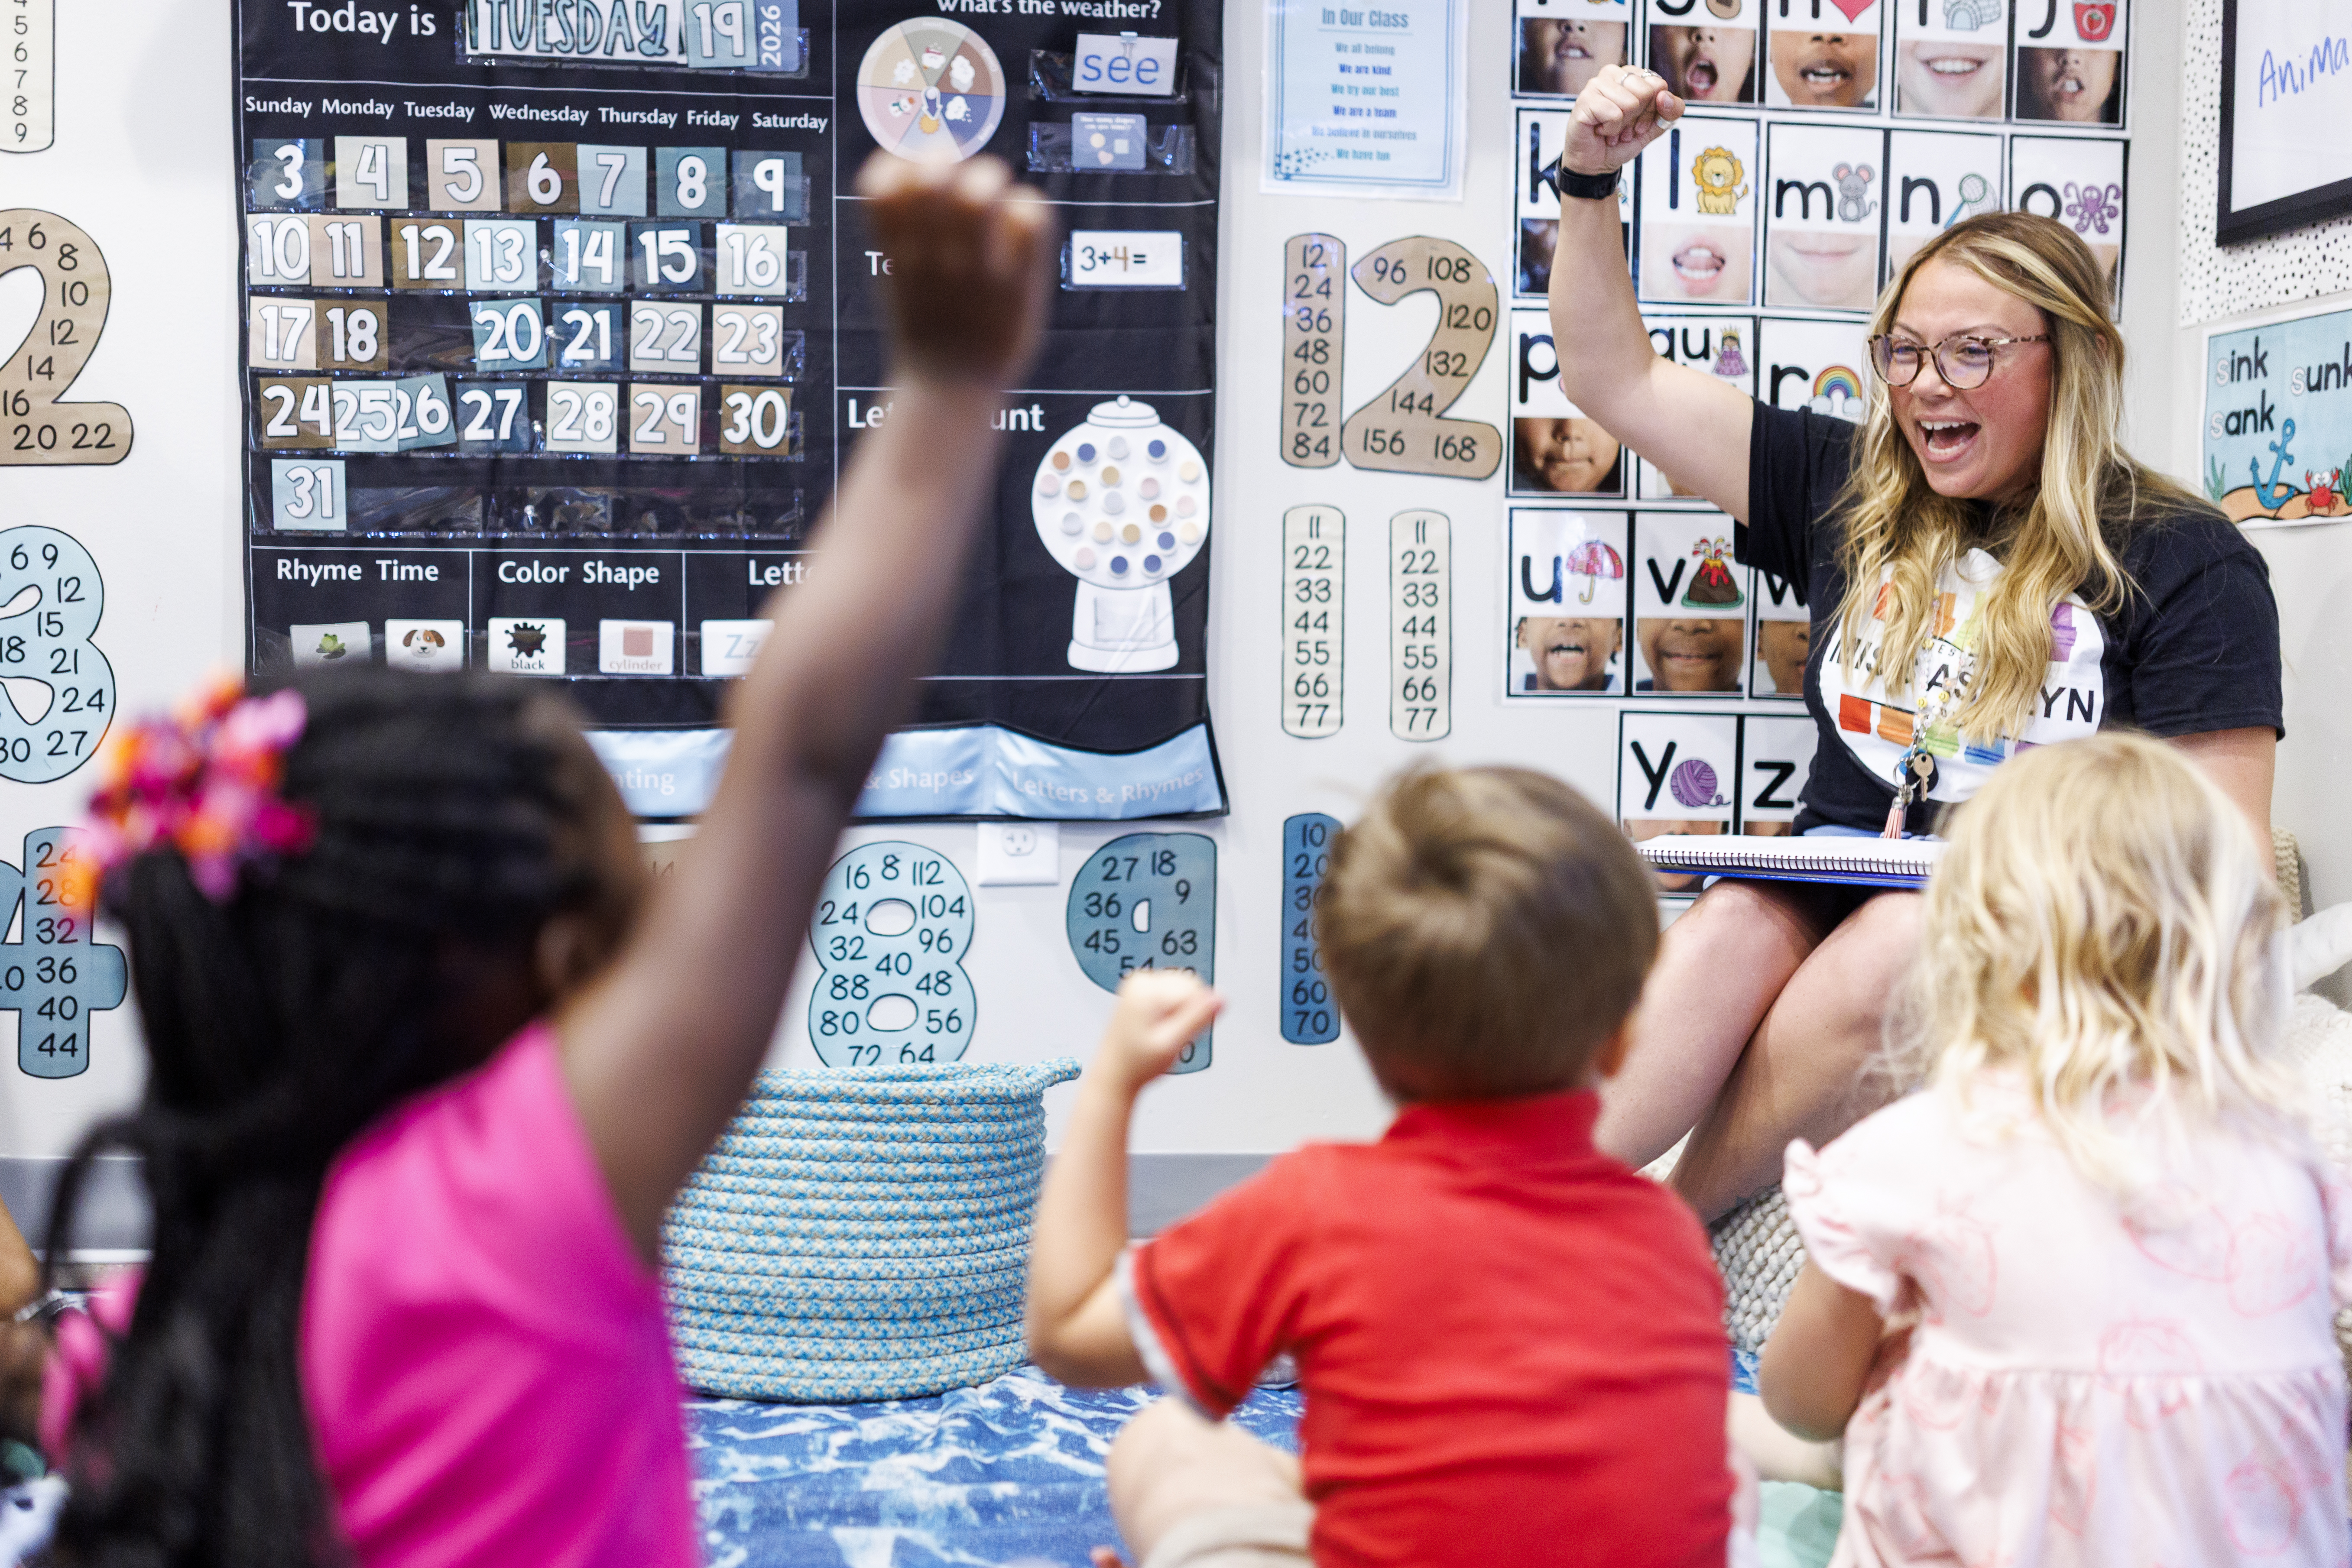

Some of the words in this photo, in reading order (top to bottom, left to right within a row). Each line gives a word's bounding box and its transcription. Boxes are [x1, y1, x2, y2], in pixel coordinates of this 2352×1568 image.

[1018, 0, 1055, 14] the
[1061, 0, 1161, 18] weather?
[1323, 7, 1335, 24] In
[1340, 9, 1365, 26] Our
[1369, 10, 1409, 29] Class
[14, 16, 27, 35] 5
[288, 1, 398, 44] Today
[410, 5, 436, 36] is
[482, 0, 668, 56] TUESDAY
[692, 2, 746, 58] 19
[761, 4, 782, 67] 2026
[14, 42, 27, 62] 6
[15, 70, 27, 88] 7
[1081, 54, 1160, 85] see
[13, 96, 28, 116] 8
[246, 97, 313, 118] Sunday
[322, 98, 395, 119] Monday
[404, 102, 475, 123] Tuesday
[489, 104, 589, 126] Wednesday
[598, 107, 678, 129] Thursday
[687, 110, 740, 130] Friday
[753, 112, 828, 133] Saturday
[15, 123, 26, 143] 9
[274, 144, 304, 200] 3
[356, 144, 388, 201] 4
[442, 147, 483, 204] 5
[527, 152, 562, 205] 6
[596, 153, 626, 208] 7
[676, 155, 707, 210] 8
[753, 158, 785, 212] 9
[1775, 178, 1833, 221] m
[1901, 176, 1940, 224] n
[2020, 182, 2062, 219] o
[28, 223, 46, 249] 6
[58, 243, 78, 270] 8
[253, 217, 310, 280] 10
[324, 221, 364, 278] 11
[399, 224, 457, 280] 12
[473, 227, 524, 282] 13
[562, 229, 614, 284] 14
[638, 230, 697, 285] 15
[726, 233, 780, 287] 16
[1303, 244, 1328, 268] 12
[1374, 257, 1406, 285] 96
[1428, 256, 1472, 284] 108
[62, 281, 88, 307] 10
[1294, 274, 1331, 300] 24
[1296, 306, 1332, 334] 36
[1447, 303, 1491, 331] 120
[51, 319, 78, 346] 12
[259, 305, 311, 361] 17
[326, 307, 379, 363] 18
[474, 303, 541, 362] 20
[562, 309, 611, 361] 21
[632, 308, 698, 362] 22
[716, 311, 779, 364] 23
[1294, 339, 1329, 365] 48
[1426, 350, 1469, 377] 132
[2216, 336, 2268, 386] sink
[28, 355, 54, 381] 14
[1519, 333, 1560, 404] p
[1294, 369, 1329, 395] 60
[1770, 364, 1810, 407] r
[3, 389, 29, 416] 16
[1294, 403, 1329, 427] 72
[1392, 389, 1434, 417] 144
[2210, 389, 2274, 440] sank
[262, 384, 332, 437] 24
[333, 389, 397, 441] 25
[397, 383, 450, 439] 26
[460, 388, 522, 441] 27
[551, 389, 613, 442] 28
[633, 392, 697, 444] 29
[723, 389, 788, 449] 30
[13, 423, 57, 450] 20
[71, 423, 116, 449] 22
[1293, 432, 1329, 459] 84
[1363, 428, 1405, 456] 156
[1434, 434, 1477, 462] 168
[285, 466, 334, 519] 31
[1309, 515, 1320, 539] 11
[11, 544, 28, 570] 6
[42, 543, 58, 569] 9
[1294, 545, 1333, 570] 22
[277, 558, 362, 587] Rhyme
[376, 559, 439, 581] Time
[498, 560, 570, 584] Color
[583, 560, 660, 591] Shape
[1522, 555, 1562, 603] u
[1647, 557, 1686, 605] v
[58, 577, 85, 603] 12
[1295, 578, 1331, 603] 33
[37, 612, 63, 637] 15
[1294, 610, 1329, 633] 44
[50, 648, 78, 674] 21
[511, 658, 545, 671] black
[1295, 641, 1330, 665] 55
[609, 660, 663, 674] cylinder
[1294, 672, 1329, 698] 66
[62, 687, 105, 713] 24
[1297, 703, 1330, 728] 77
[47, 730, 88, 756] 27
[889, 768, 974, 794] Shapes
[1012, 772, 1088, 803] Letters
[1096, 788, 1115, 804] &
[1122, 768, 1204, 802] Rhymes
[1630, 741, 1677, 810] y
[1753, 761, 1796, 808] z
[1302, 823, 1326, 848] 10
[882, 854, 900, 880] 8
[913, 861, 944, 885] 112
[1102, 856, 1139, 881] 27
[1152, 850, 1177, 876] 18
[847, 865, 869, 889] 16
[1085, 892, 1121, 917] 36
[1175, 879, 1191, 905] 9
[821, 901, 858, 925] 24
[921, 895, 965, 918] 104
[36, 917, 78, 944] 32
[919, 929, 952, 953] 96
[1085, 929, 1121, 954] 45
[1162, 929, 1197, 955] 63
[830, 936, 867, 961] 32
[36, 956, 77, 983] 36
[876, 952, 912, 976] 40
[830, 975, 869, 1000] 88
[916, 971, 952, 996] 48
[1292, 980, 1327, 1006] 60
[37, 995, 78, 1020] 40
[926, 1008, 962, 1033] 56
[821, 1011, 859, 1036] 80
[1294, 1011, 1330, 1036] 70
[37, 1032, 78, 1057] 44
